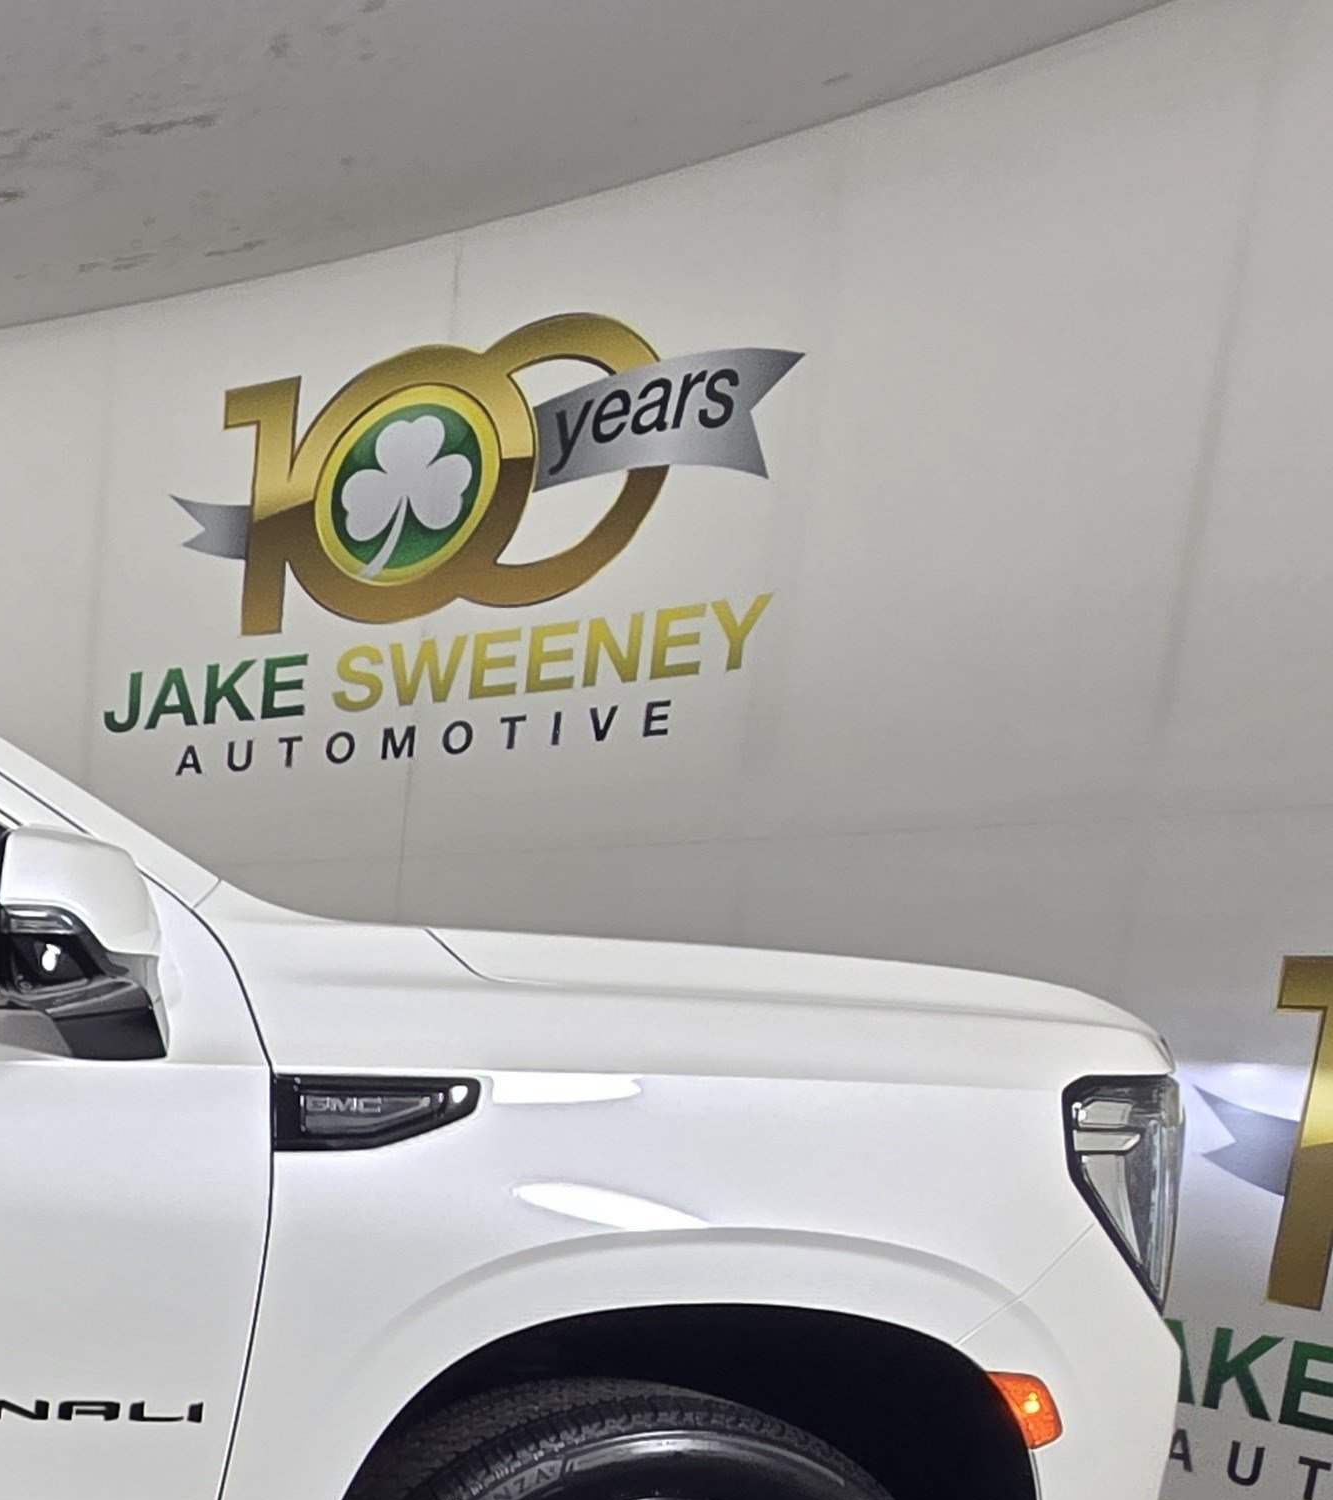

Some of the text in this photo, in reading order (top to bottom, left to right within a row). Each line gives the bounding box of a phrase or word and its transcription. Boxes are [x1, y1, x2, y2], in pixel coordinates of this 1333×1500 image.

[223, 311, 670, 636] 100
[547, 364, 740, 477] years
[103, 591, 776, 734] JAKE SWEENEY
[175, 698, 673, 777] AUTOMOTIVE
[305, 1096, 382, 1114] GMC
